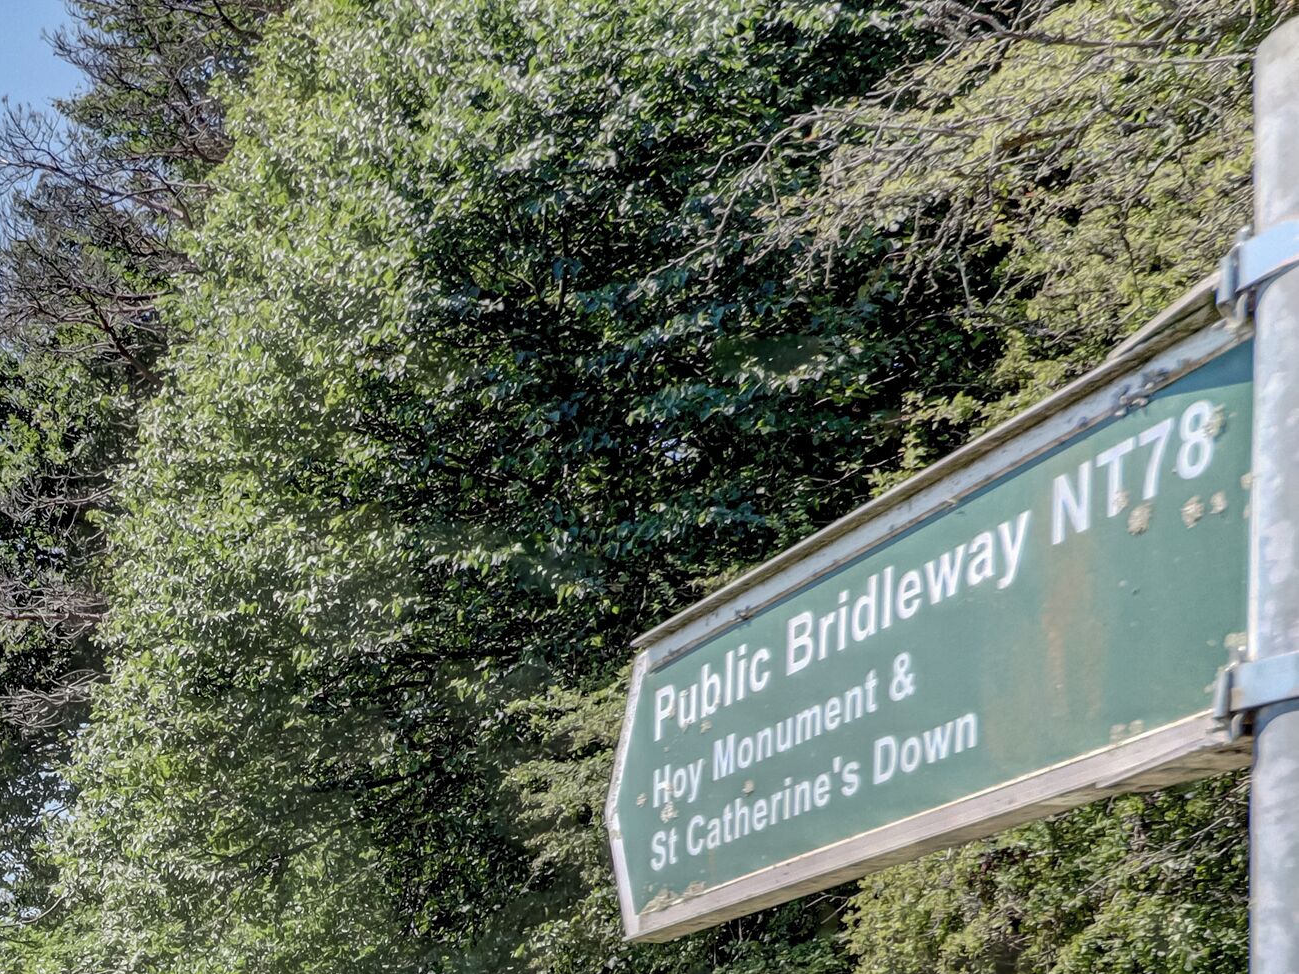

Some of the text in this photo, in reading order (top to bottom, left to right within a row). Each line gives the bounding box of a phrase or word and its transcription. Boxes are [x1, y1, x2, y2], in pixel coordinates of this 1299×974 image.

[653, 400, 1216, 741] Public Bridleway NT78
[650, 711, 979, 872] St Catherine's Down
[652, 651, 917, 808] Hoy Monument &
